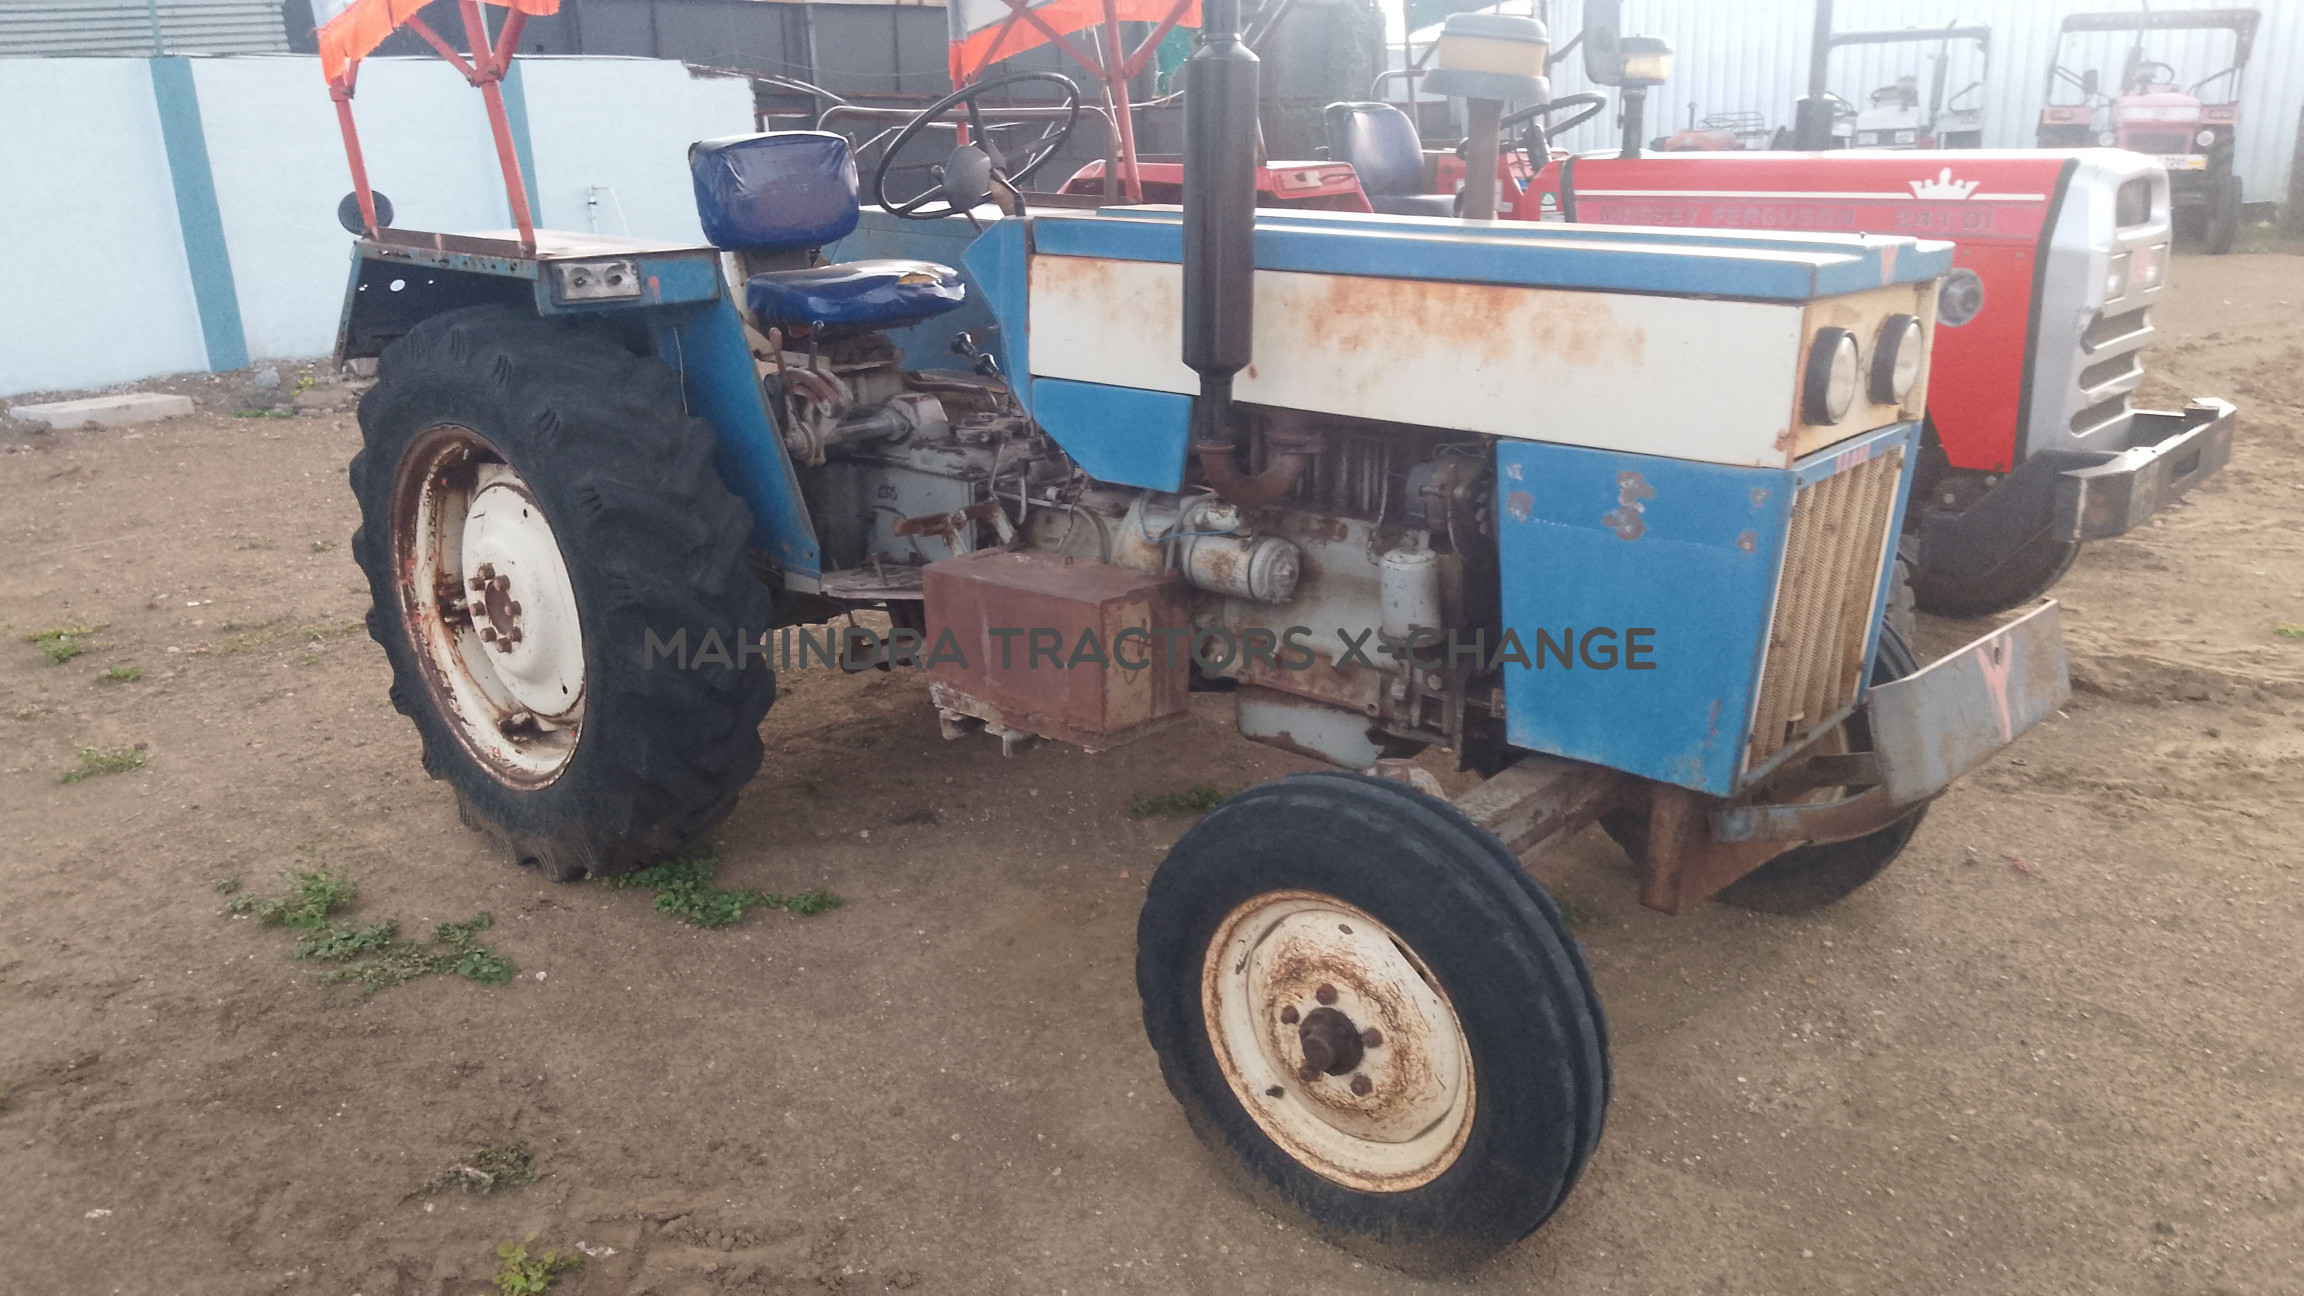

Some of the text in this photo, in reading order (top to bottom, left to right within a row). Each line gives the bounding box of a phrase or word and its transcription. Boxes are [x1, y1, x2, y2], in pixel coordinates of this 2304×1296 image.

[1600, 206, 1994, 229] MASSEY FERGUSON 241 DI
